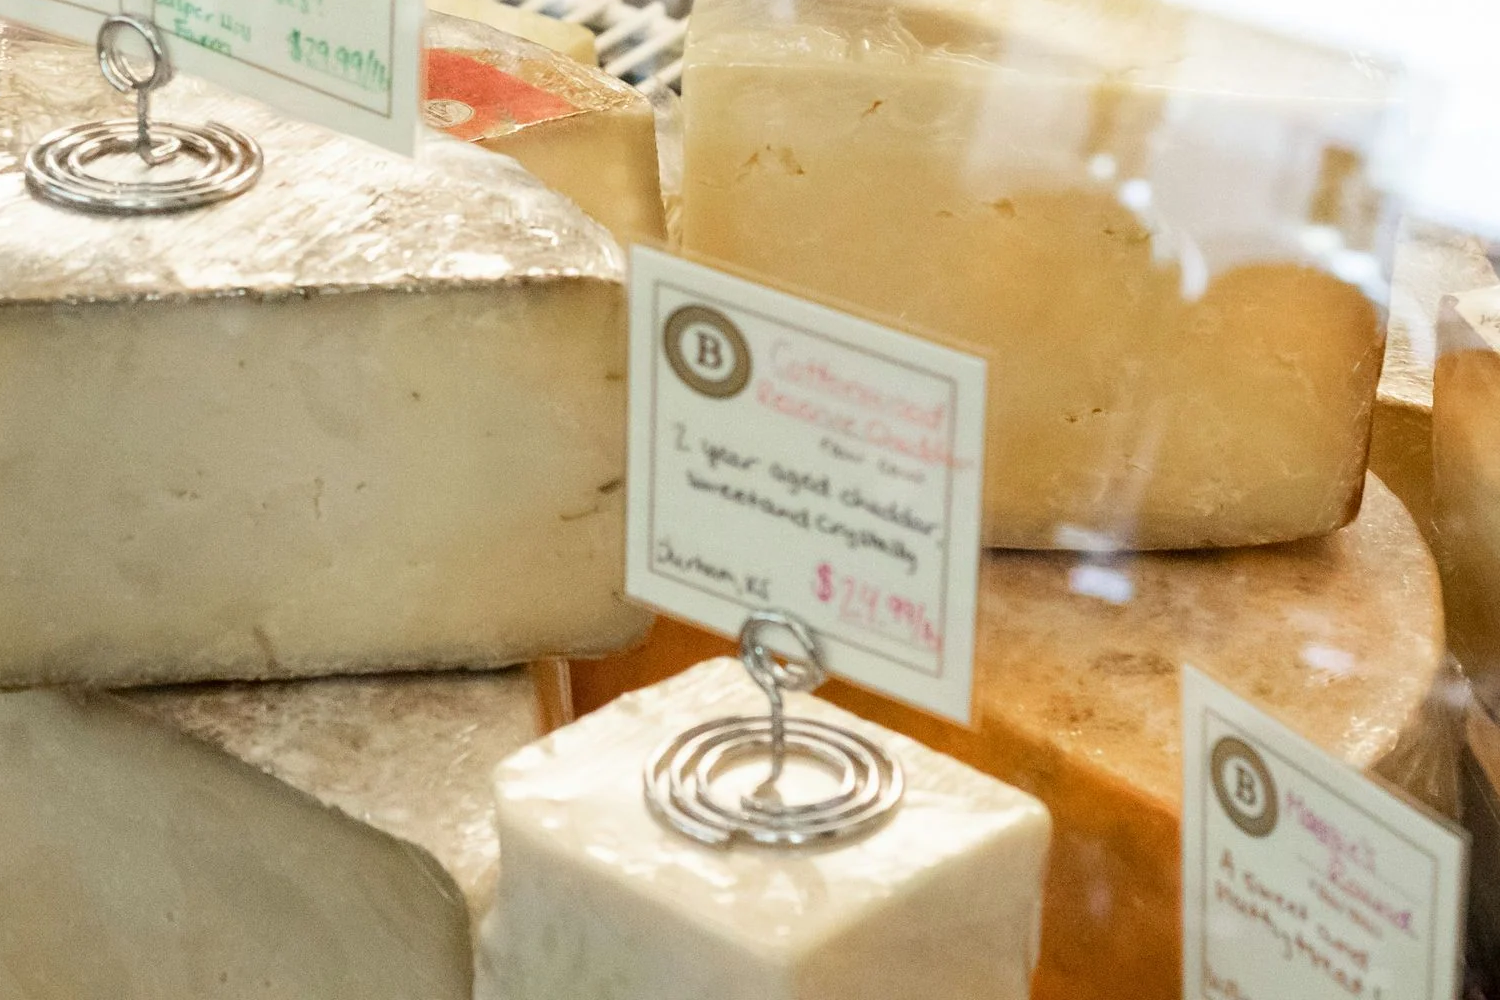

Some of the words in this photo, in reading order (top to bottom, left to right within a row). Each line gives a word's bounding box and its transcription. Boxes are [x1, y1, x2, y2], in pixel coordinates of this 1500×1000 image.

[696, 331, 723, 370] B
[701, 439, 760, 470] year
[769, 462, 831, 496] aged
[1235, 764, 1257, 807] B
